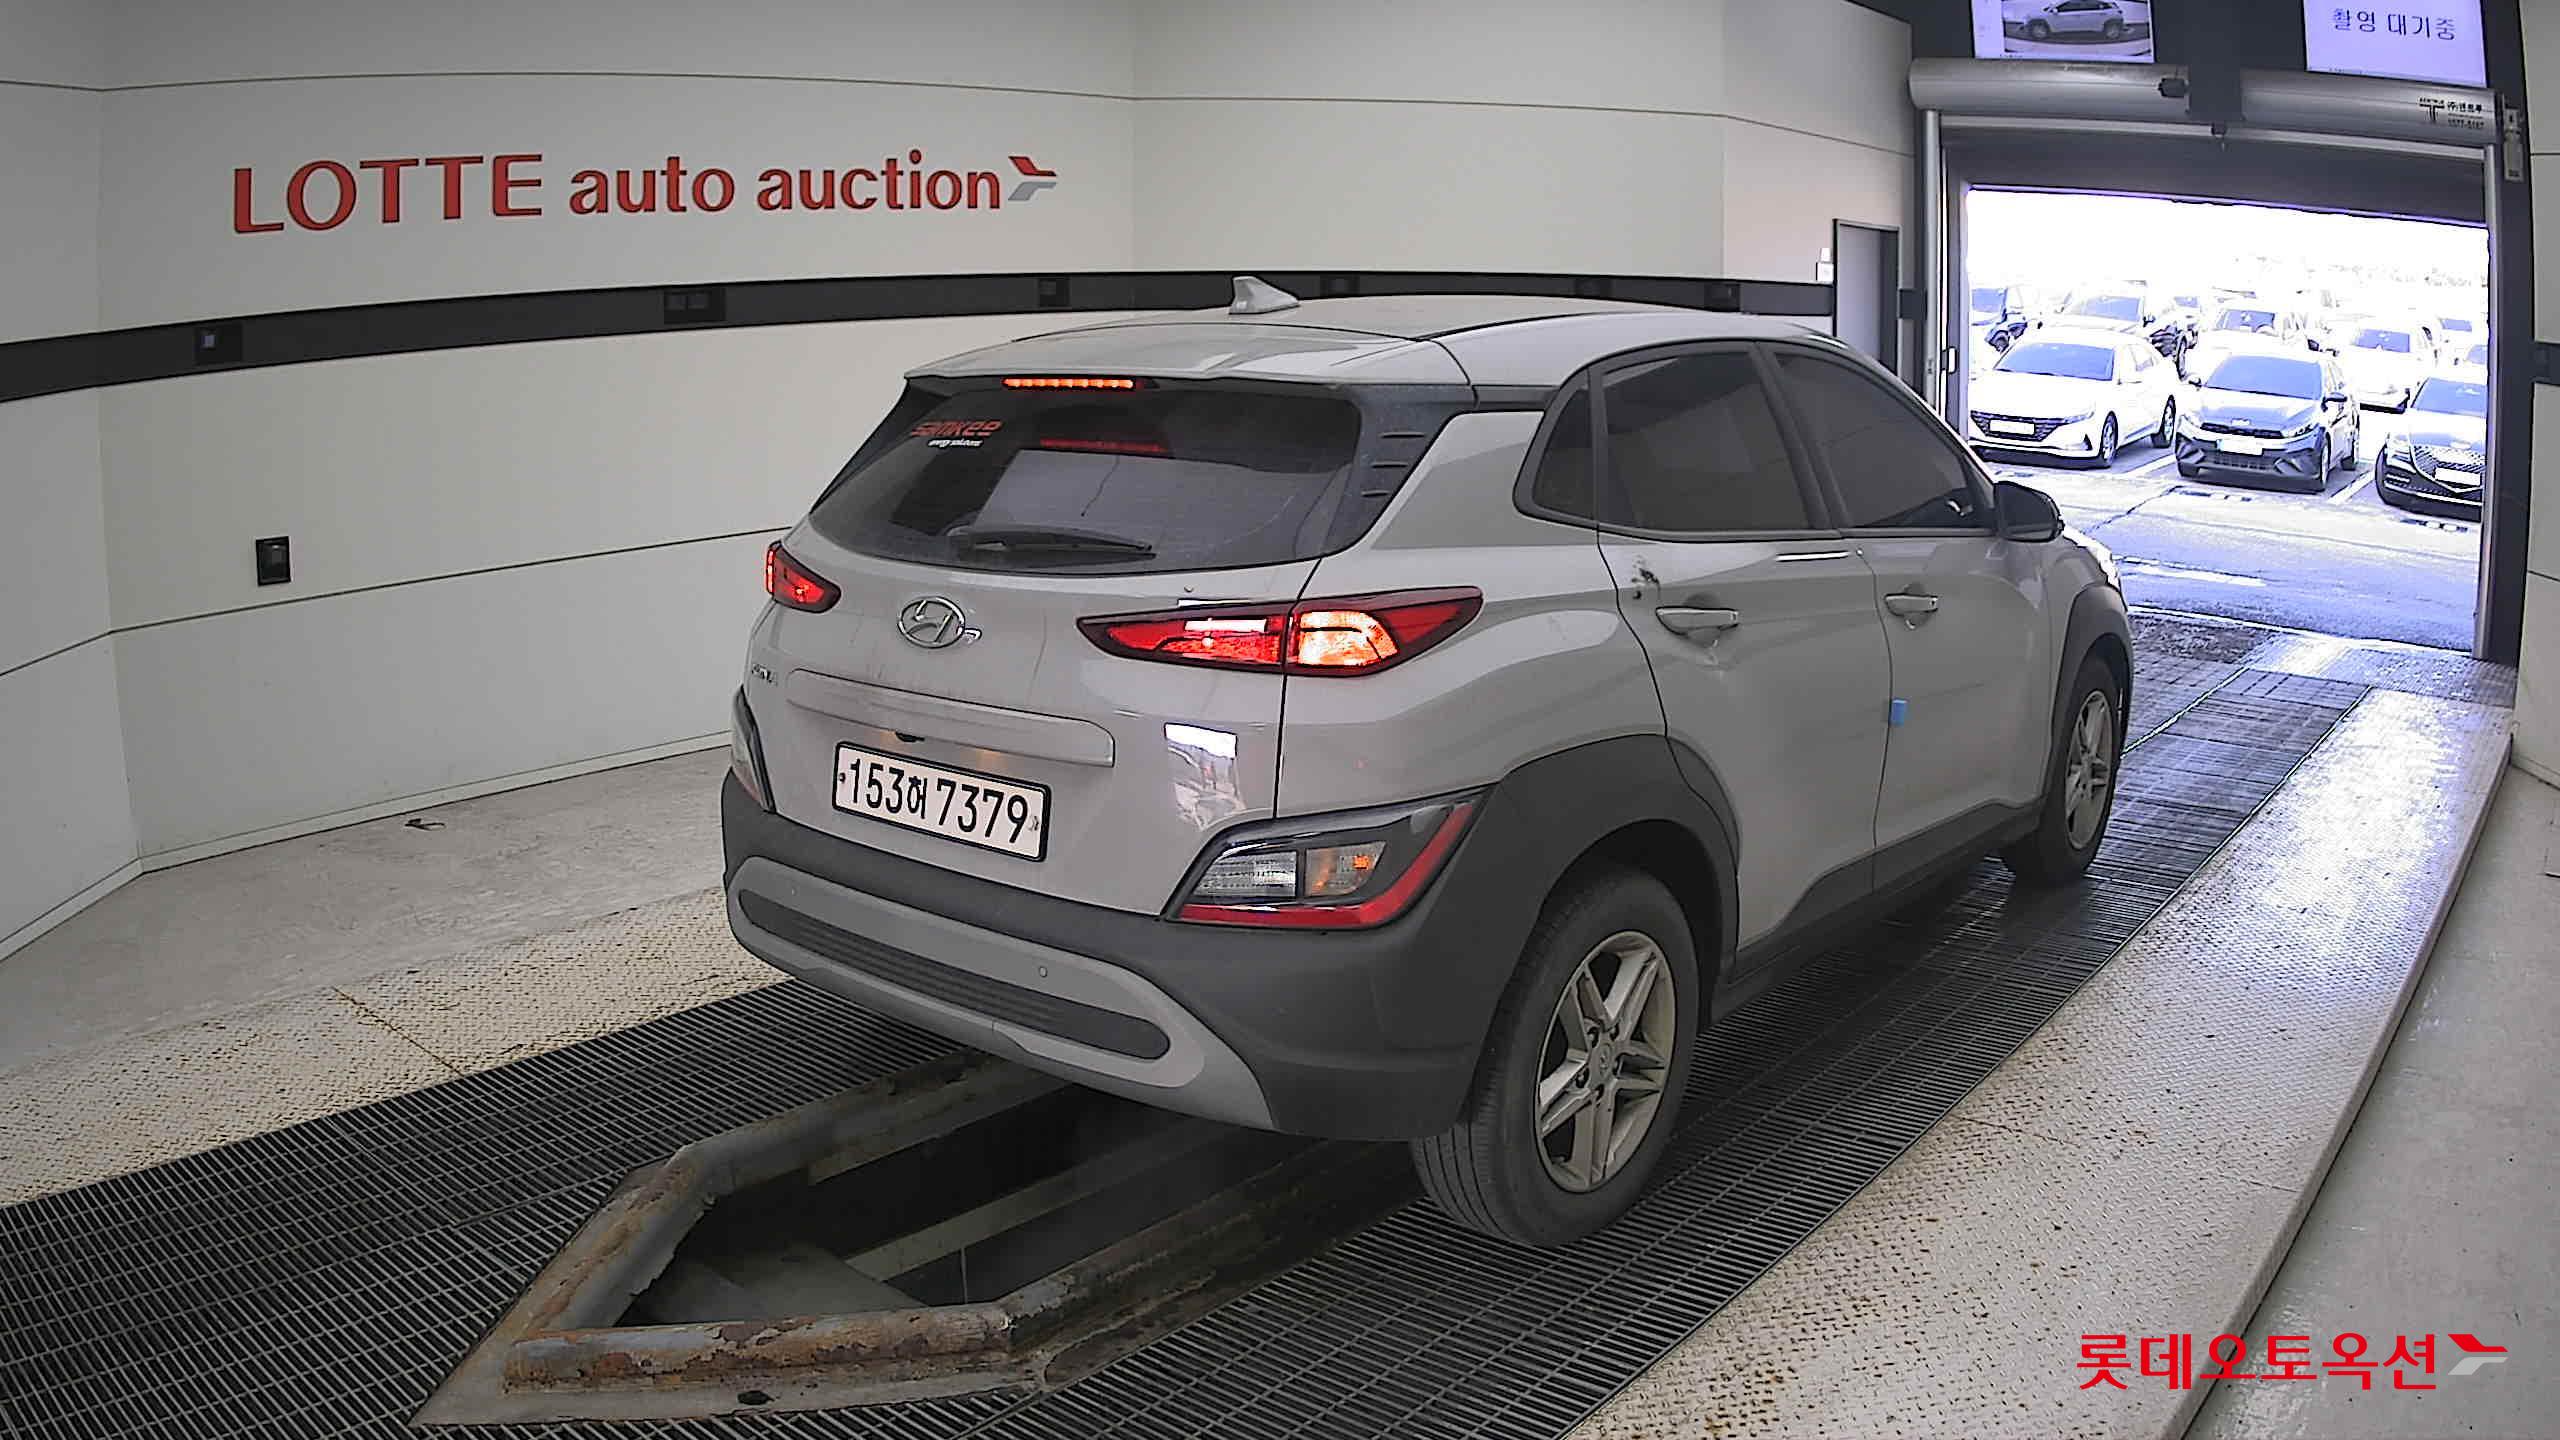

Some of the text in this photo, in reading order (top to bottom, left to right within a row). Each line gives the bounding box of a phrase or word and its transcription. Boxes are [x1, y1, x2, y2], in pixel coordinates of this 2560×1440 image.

[2334, 8, 2455, 41] 촬영 대기중
[234, 149, 1001, 234] LOTTE auto auction
